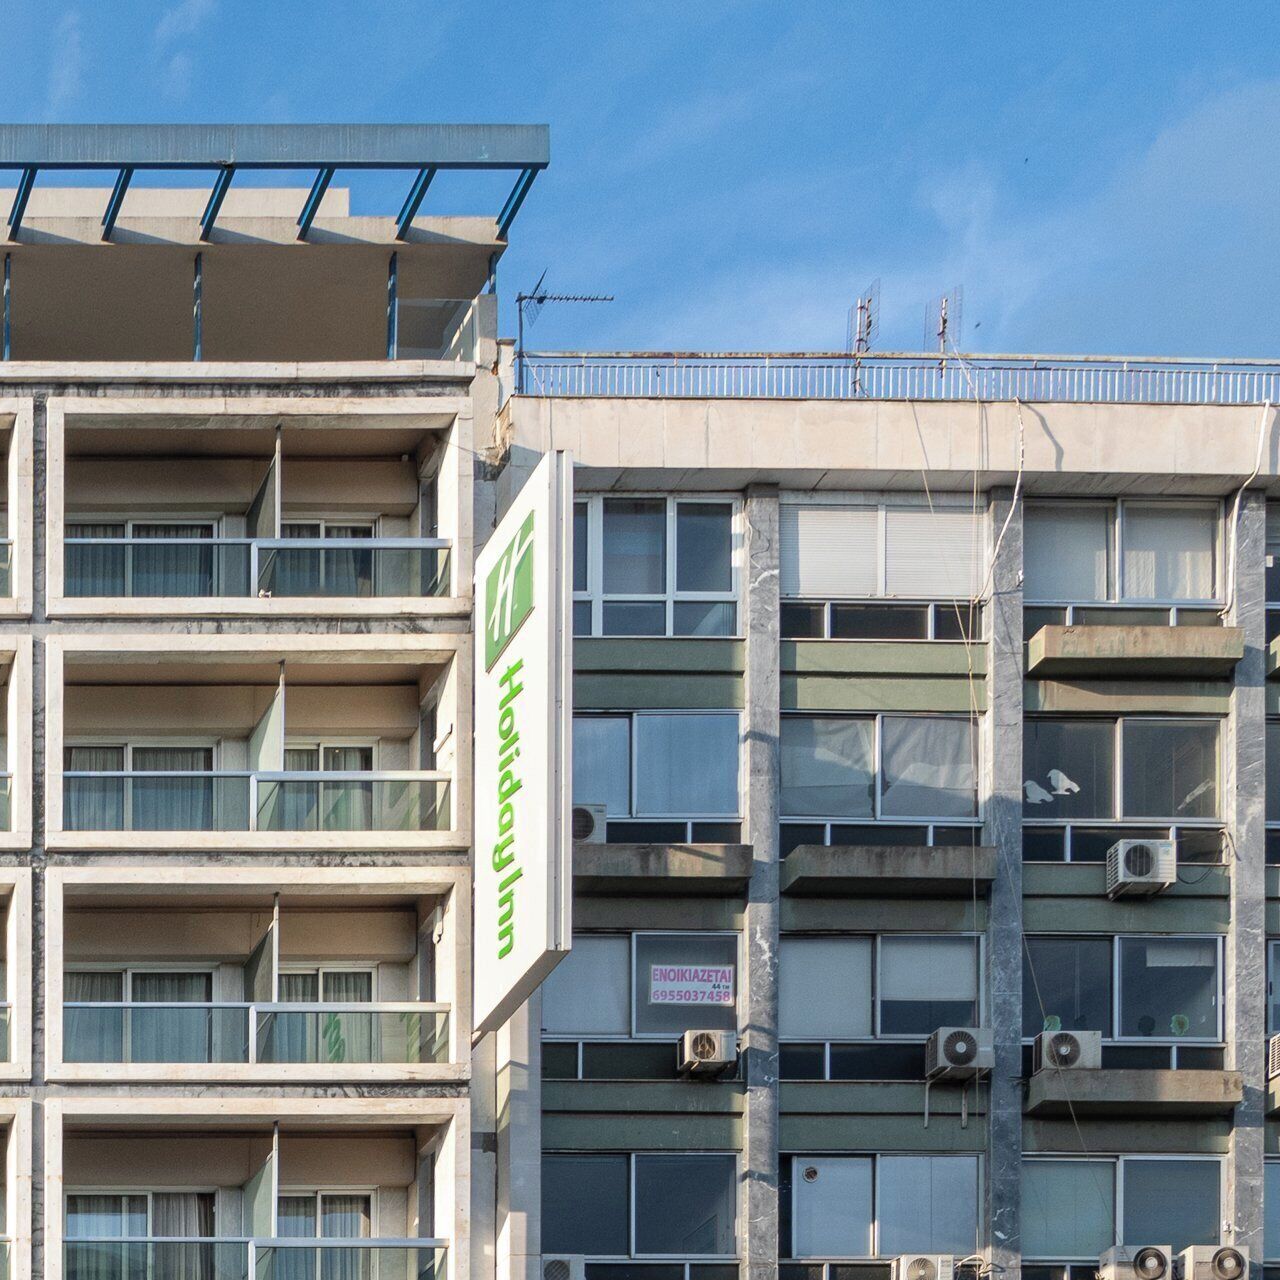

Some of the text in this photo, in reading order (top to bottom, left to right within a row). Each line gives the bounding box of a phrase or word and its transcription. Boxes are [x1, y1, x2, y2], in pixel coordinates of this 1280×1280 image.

[492, 658, 524, 960] Holiday Inn
[652, 967, 732, 983] ΕΝΟΙΚΙΑΖΕΤΑΙ
[652, 989, 731, 1002] 6955037458
